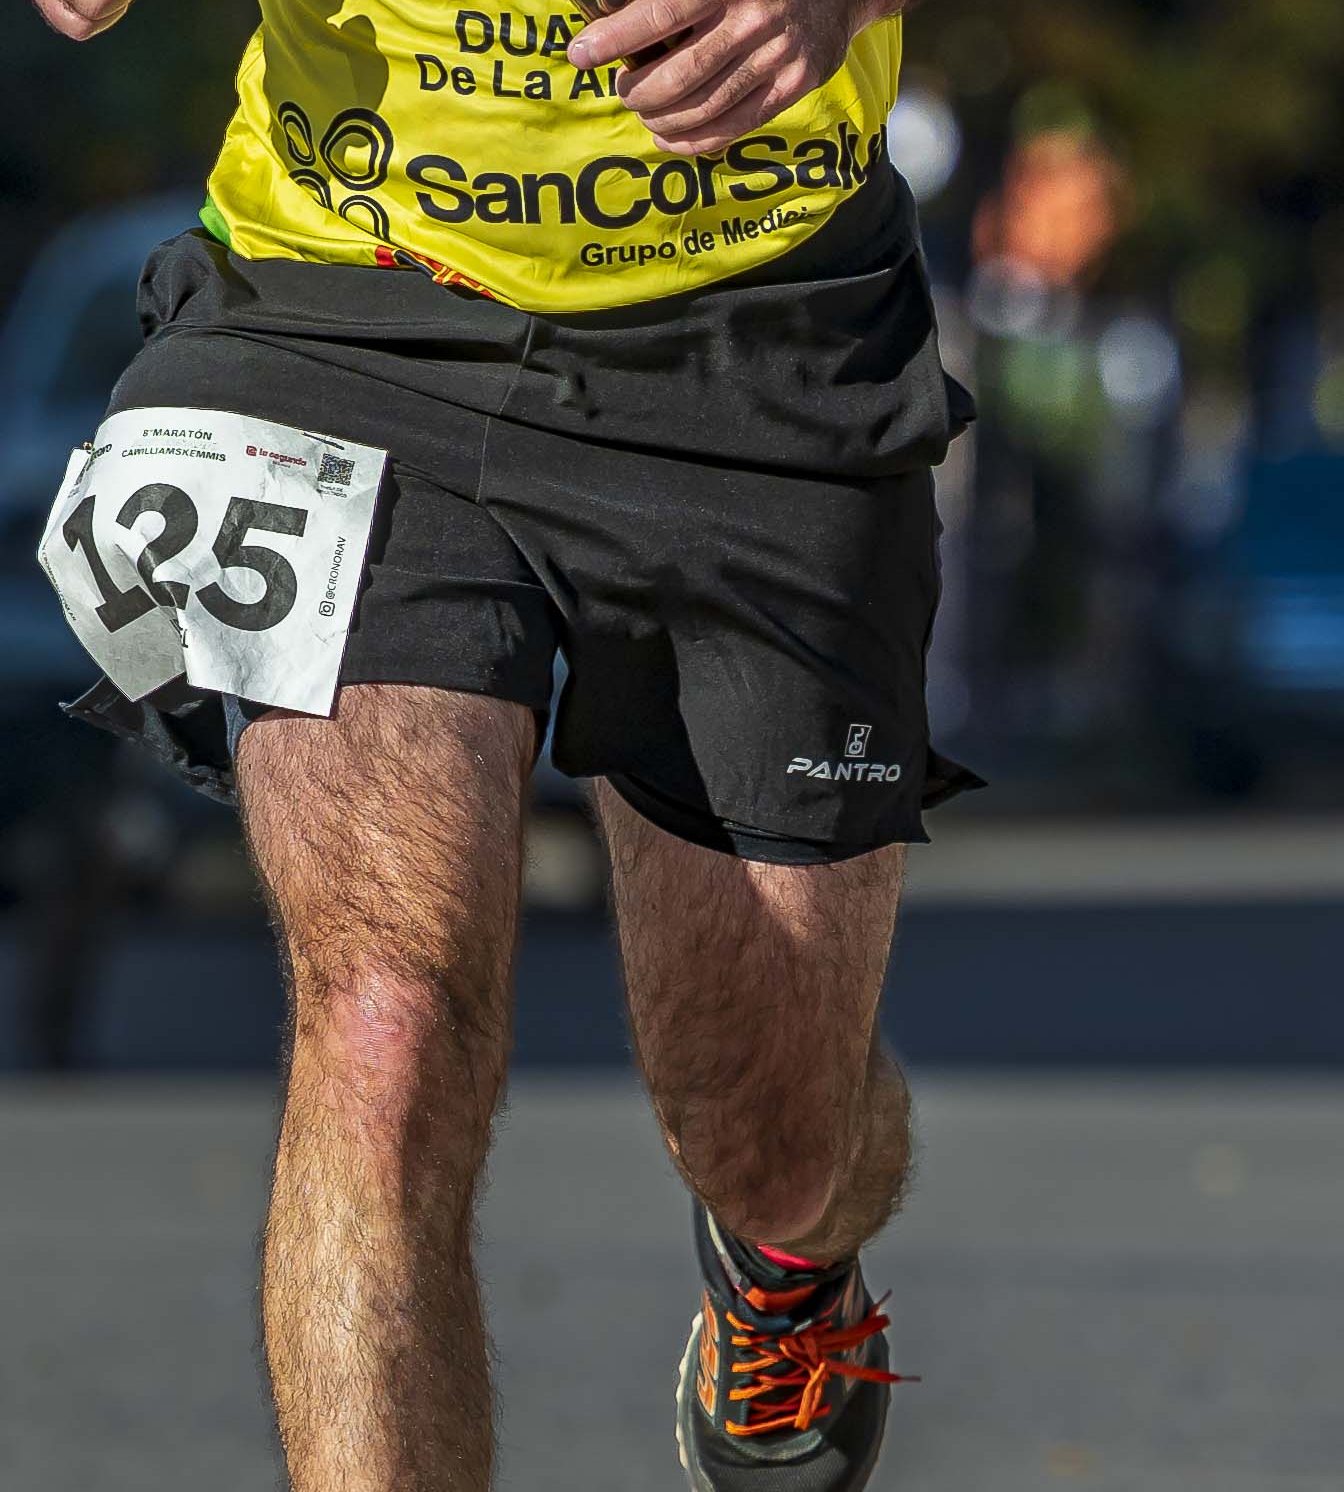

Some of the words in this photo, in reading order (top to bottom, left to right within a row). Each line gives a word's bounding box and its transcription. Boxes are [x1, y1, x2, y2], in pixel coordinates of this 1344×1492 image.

[417, 54, 477, 96] De
[493, 60, 552, 101] La
[580, 242, 676, 267] Grupo
[683, 228, 715, 256] de
[62, 482, 308, 634] 125
[325, 536, 347, 600] @CRONORAV
[786, 757, 901, 782] PANTRO
